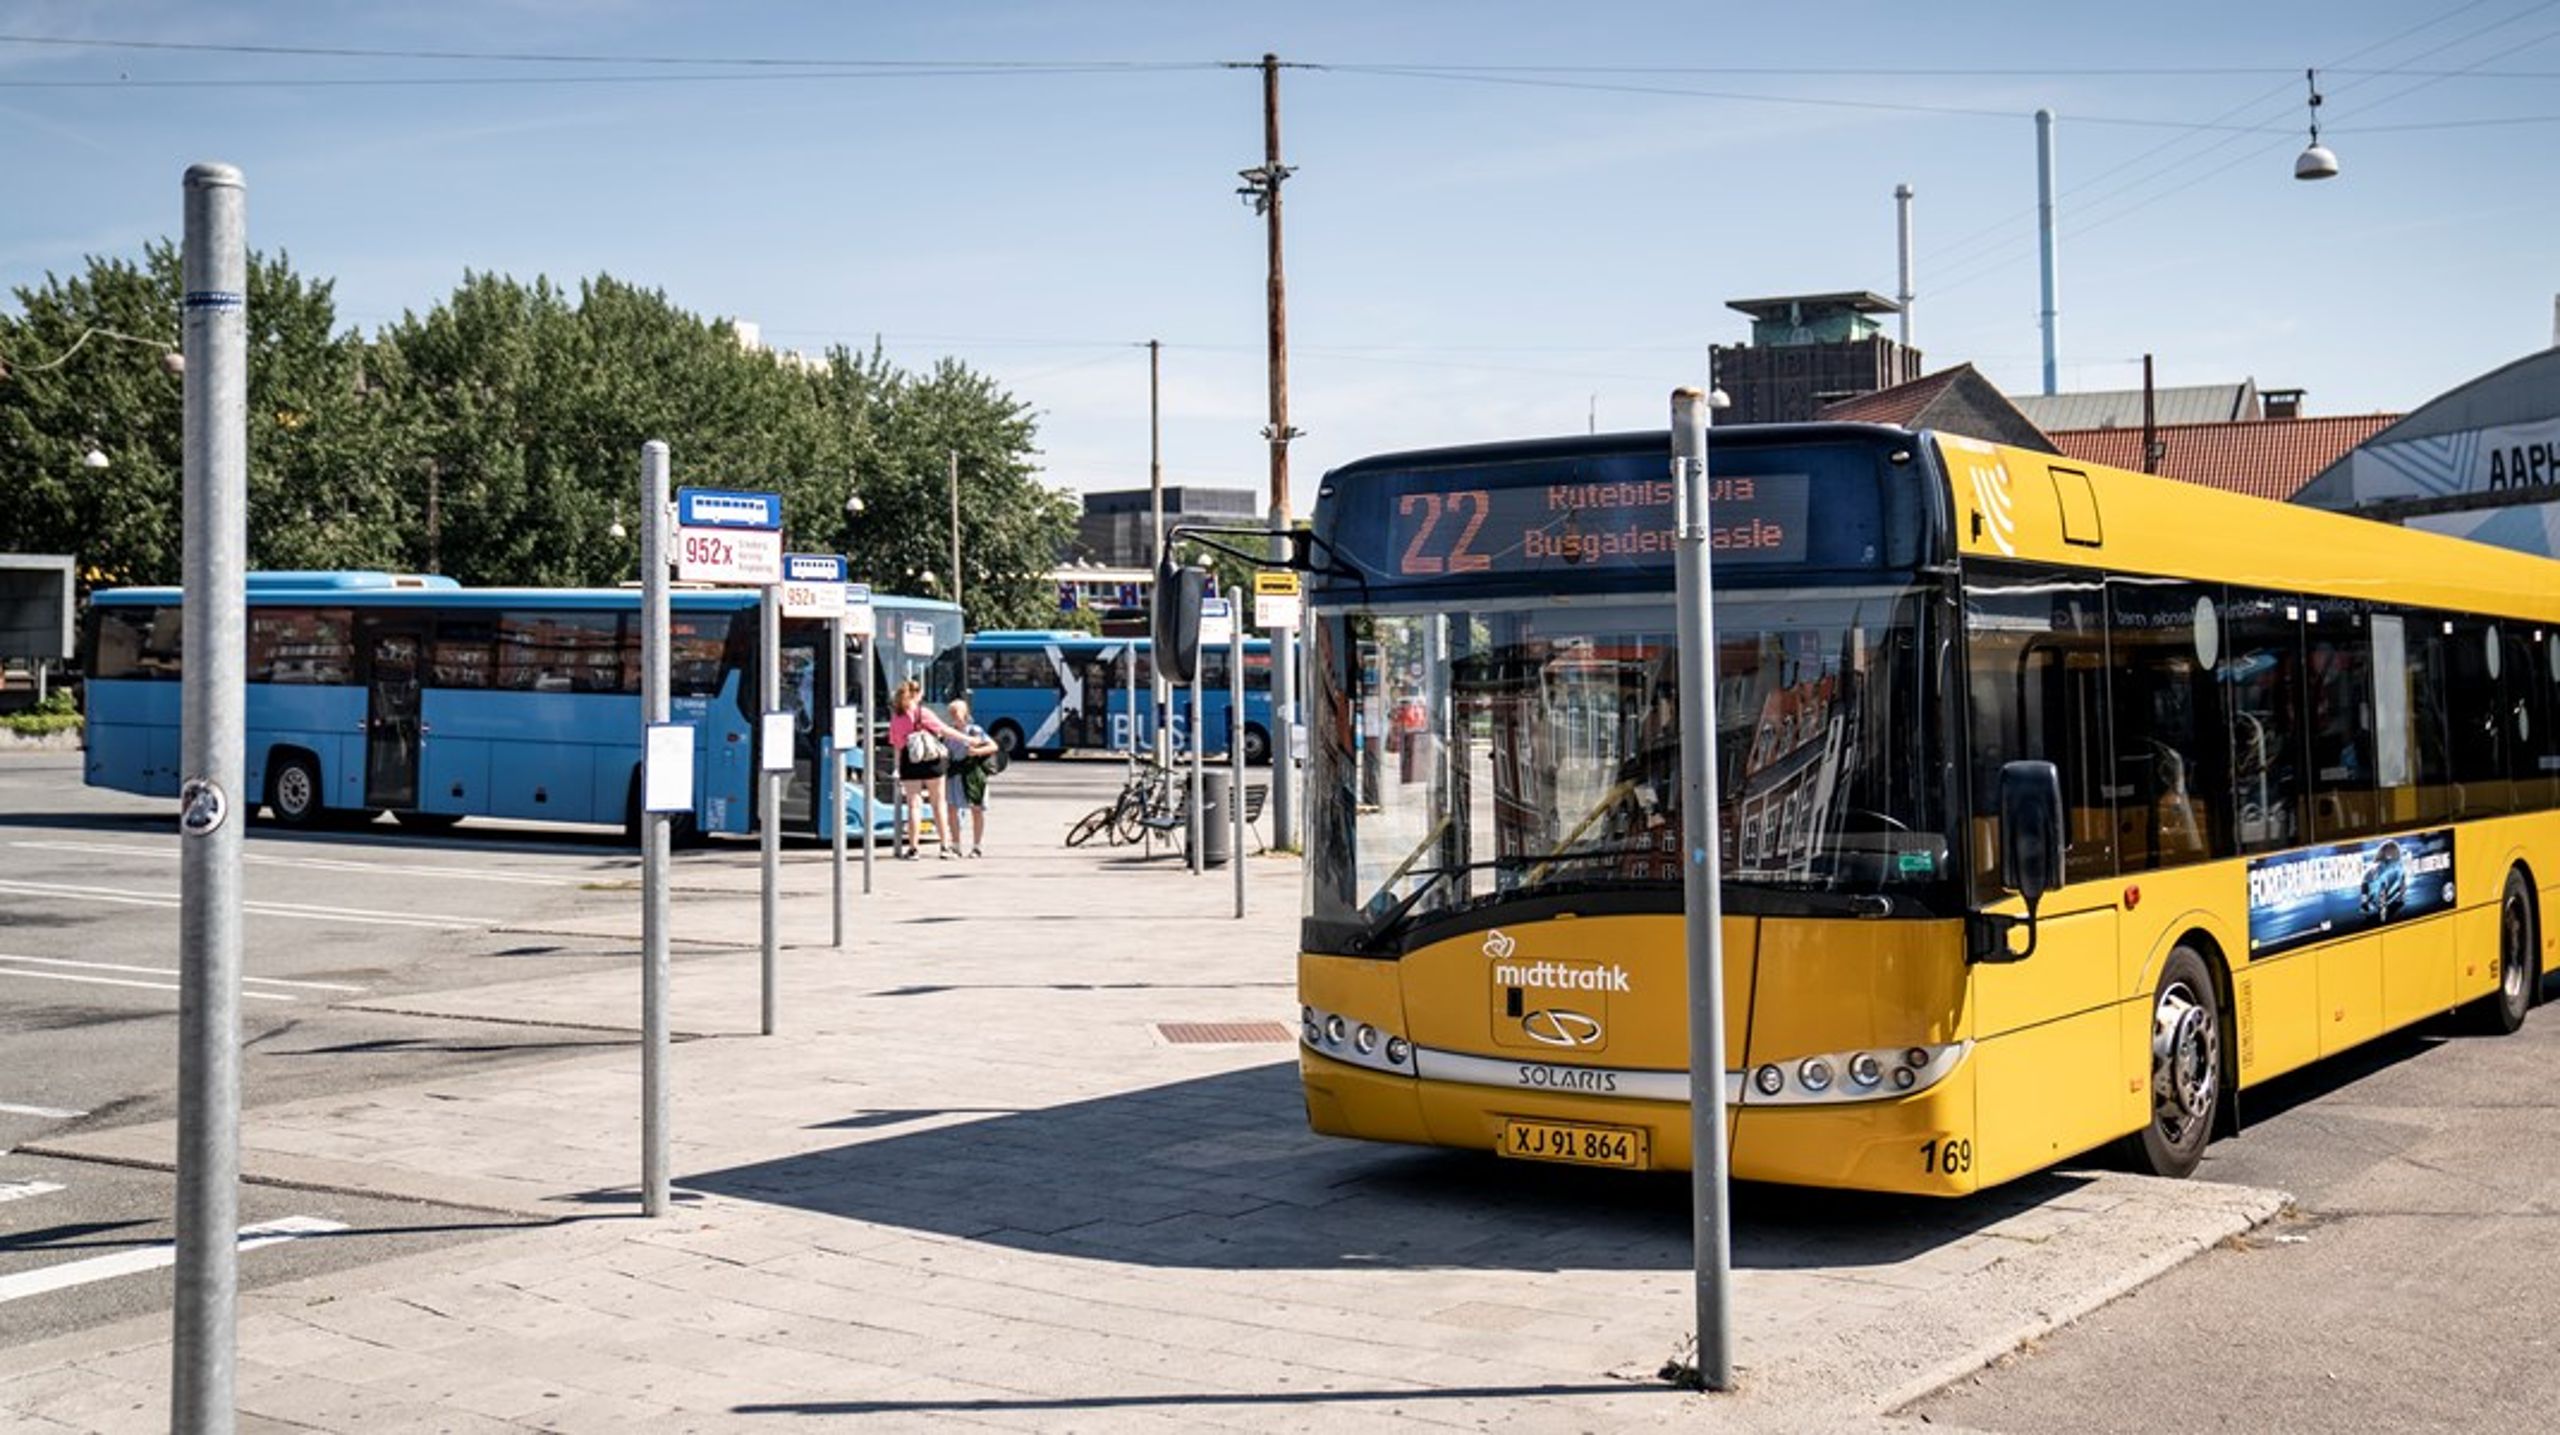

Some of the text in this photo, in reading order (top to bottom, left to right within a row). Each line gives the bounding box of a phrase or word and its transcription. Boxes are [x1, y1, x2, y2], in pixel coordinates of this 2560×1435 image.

[1548, 481, 1673, 511] Rutebils
[1400, 490, 1490, 574] 22
[1711, 518, 1784, 549] asle
[686, 537, 733, 566] 952x
[1496, 961, 1631, 992] midttrafik
[1519, 1066, 1616, 1092] SOLARIS
[1516, 1127, 1627, 1160] XJ 91 864
[1920, 1138, 1971, 1175] 169
